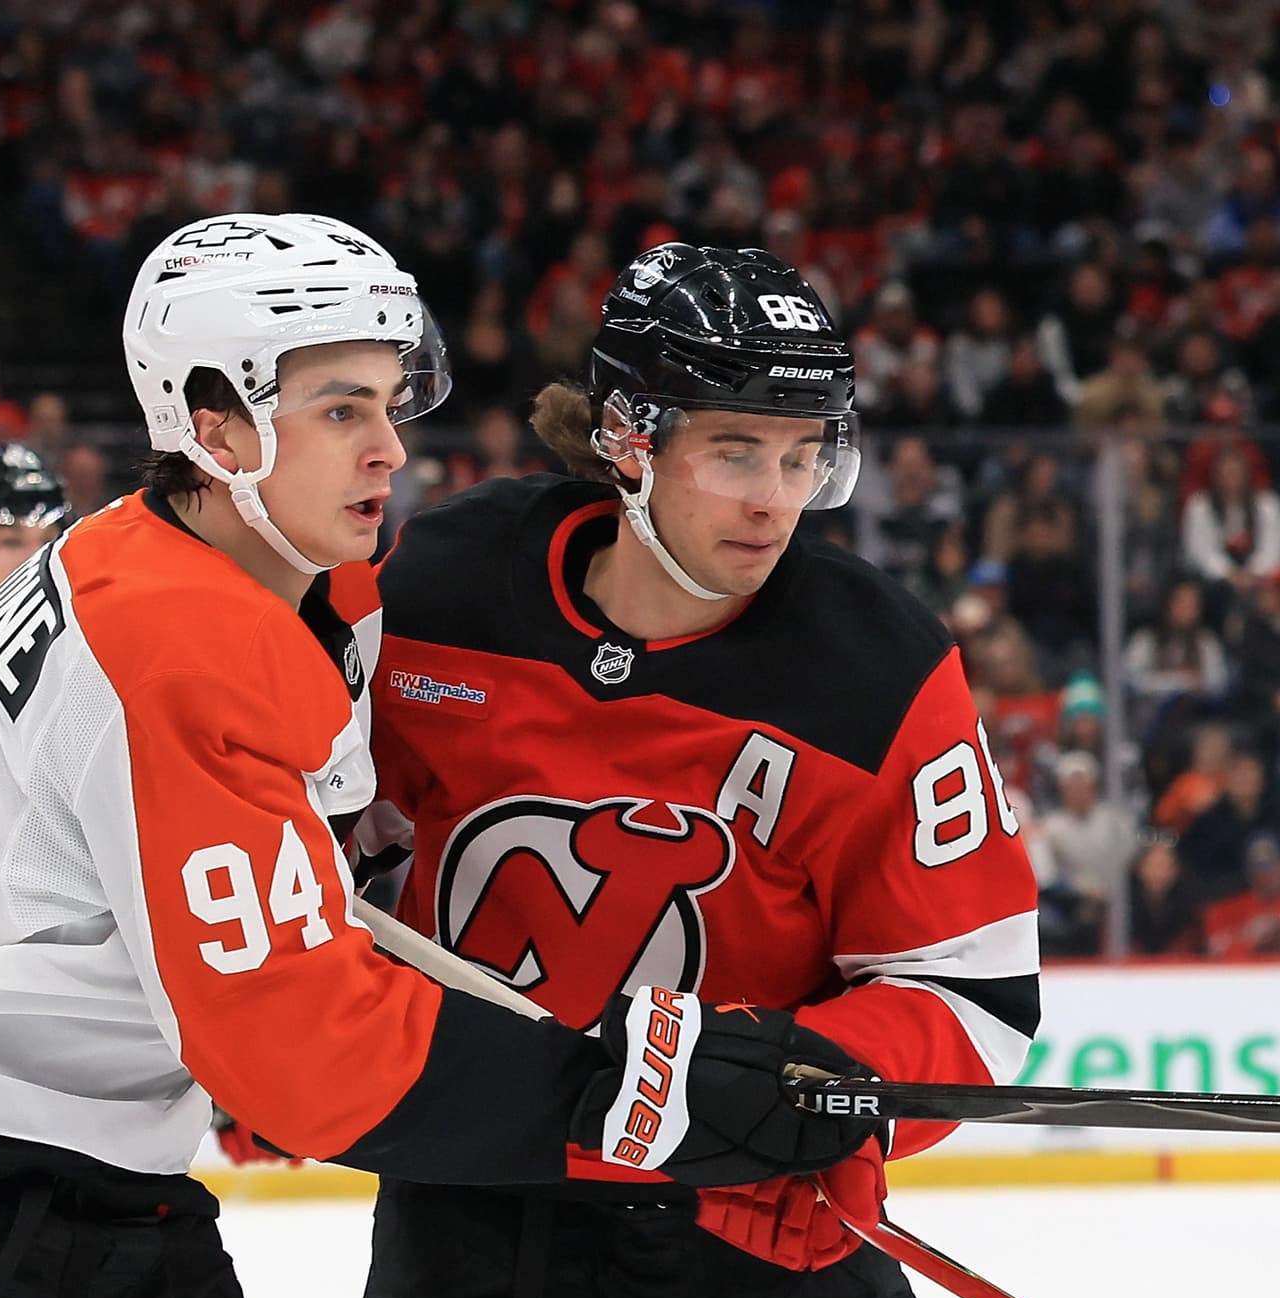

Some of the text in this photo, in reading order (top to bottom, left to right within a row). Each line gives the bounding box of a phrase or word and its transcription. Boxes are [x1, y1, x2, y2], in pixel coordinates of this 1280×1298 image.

[757, 294, 820, 332] 86
[768, 365, 834, 381] BAUER
[401, 687, 440, 704] HEALTH
[716, 729, 798, 849] A
[181, 819, 334, 975] 94
[612, 986, 685, 1167] BAUER
